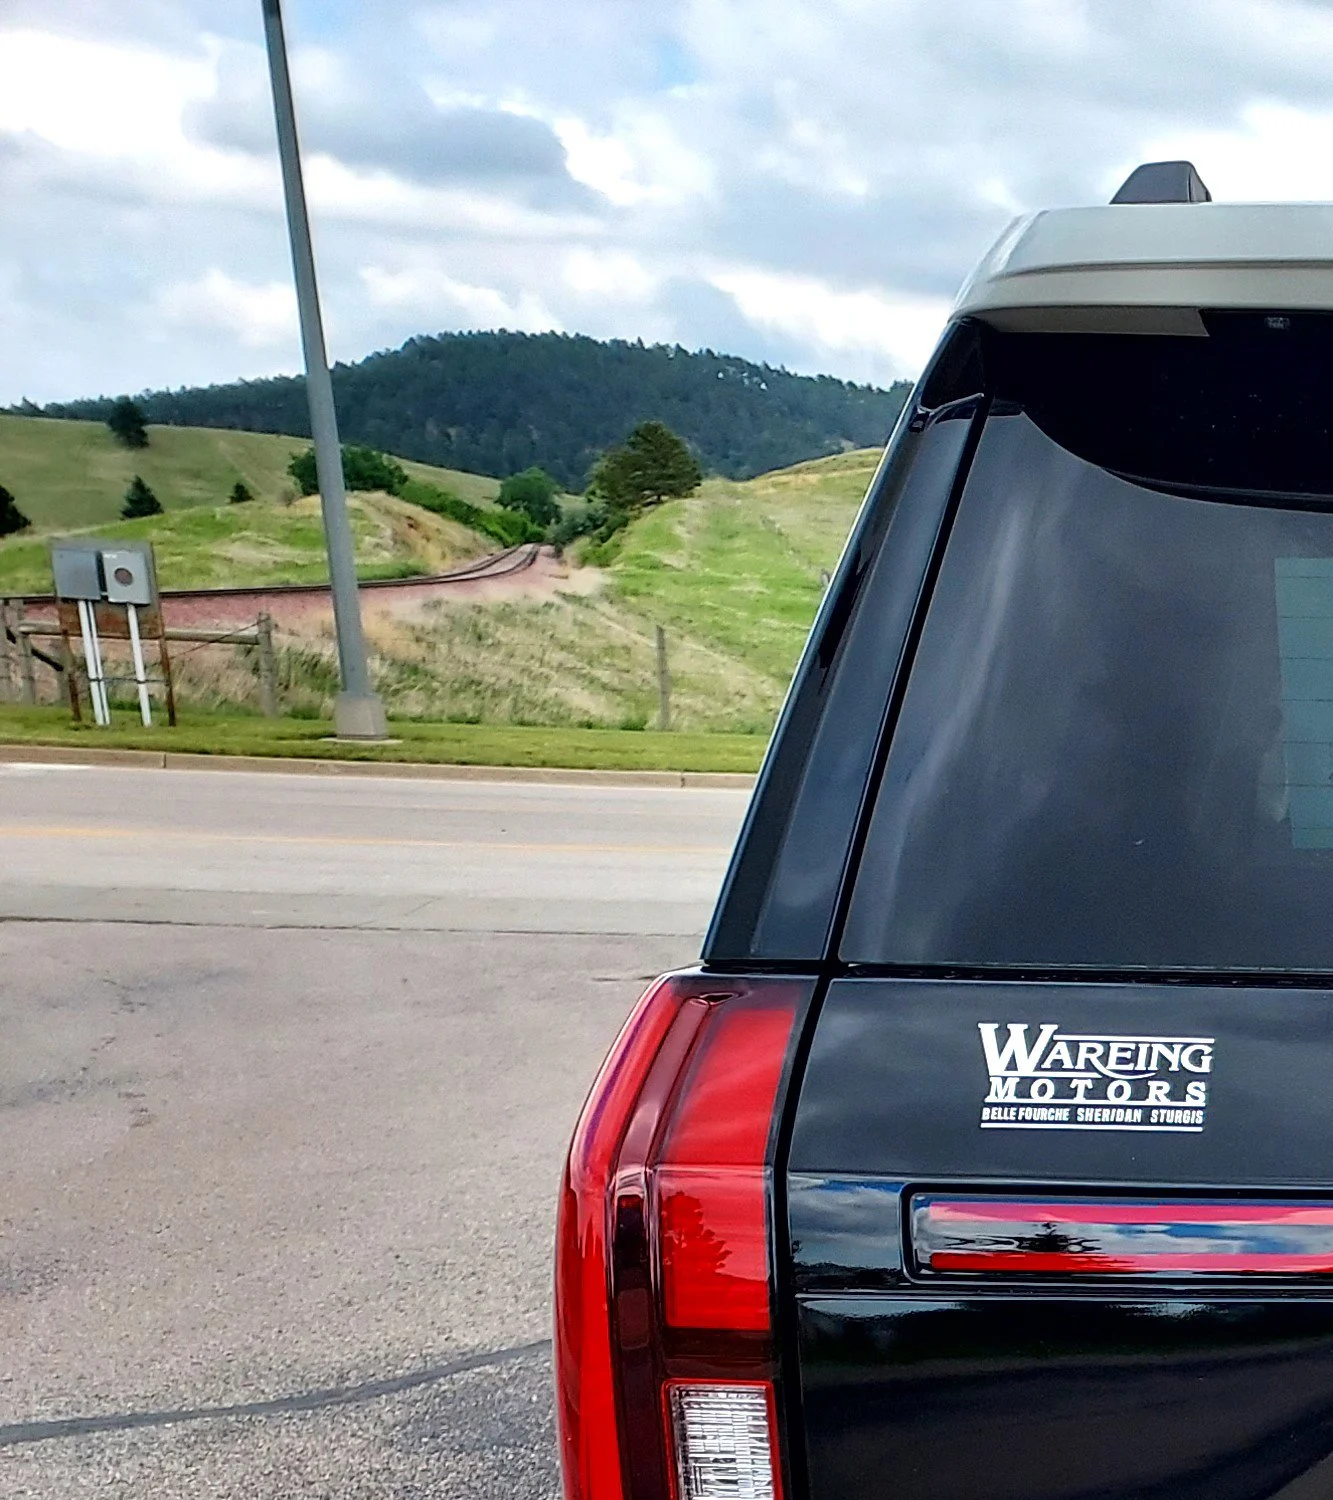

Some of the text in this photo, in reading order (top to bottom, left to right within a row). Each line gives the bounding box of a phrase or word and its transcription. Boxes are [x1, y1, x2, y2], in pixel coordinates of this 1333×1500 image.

[978, 1023, 1214, 1079] WAREING
[984, 1076, 1207, 1105] MOTORS
[982, 1107, 1204, 1125] BELLE FOURCHE SHERIDAN STURGIS
